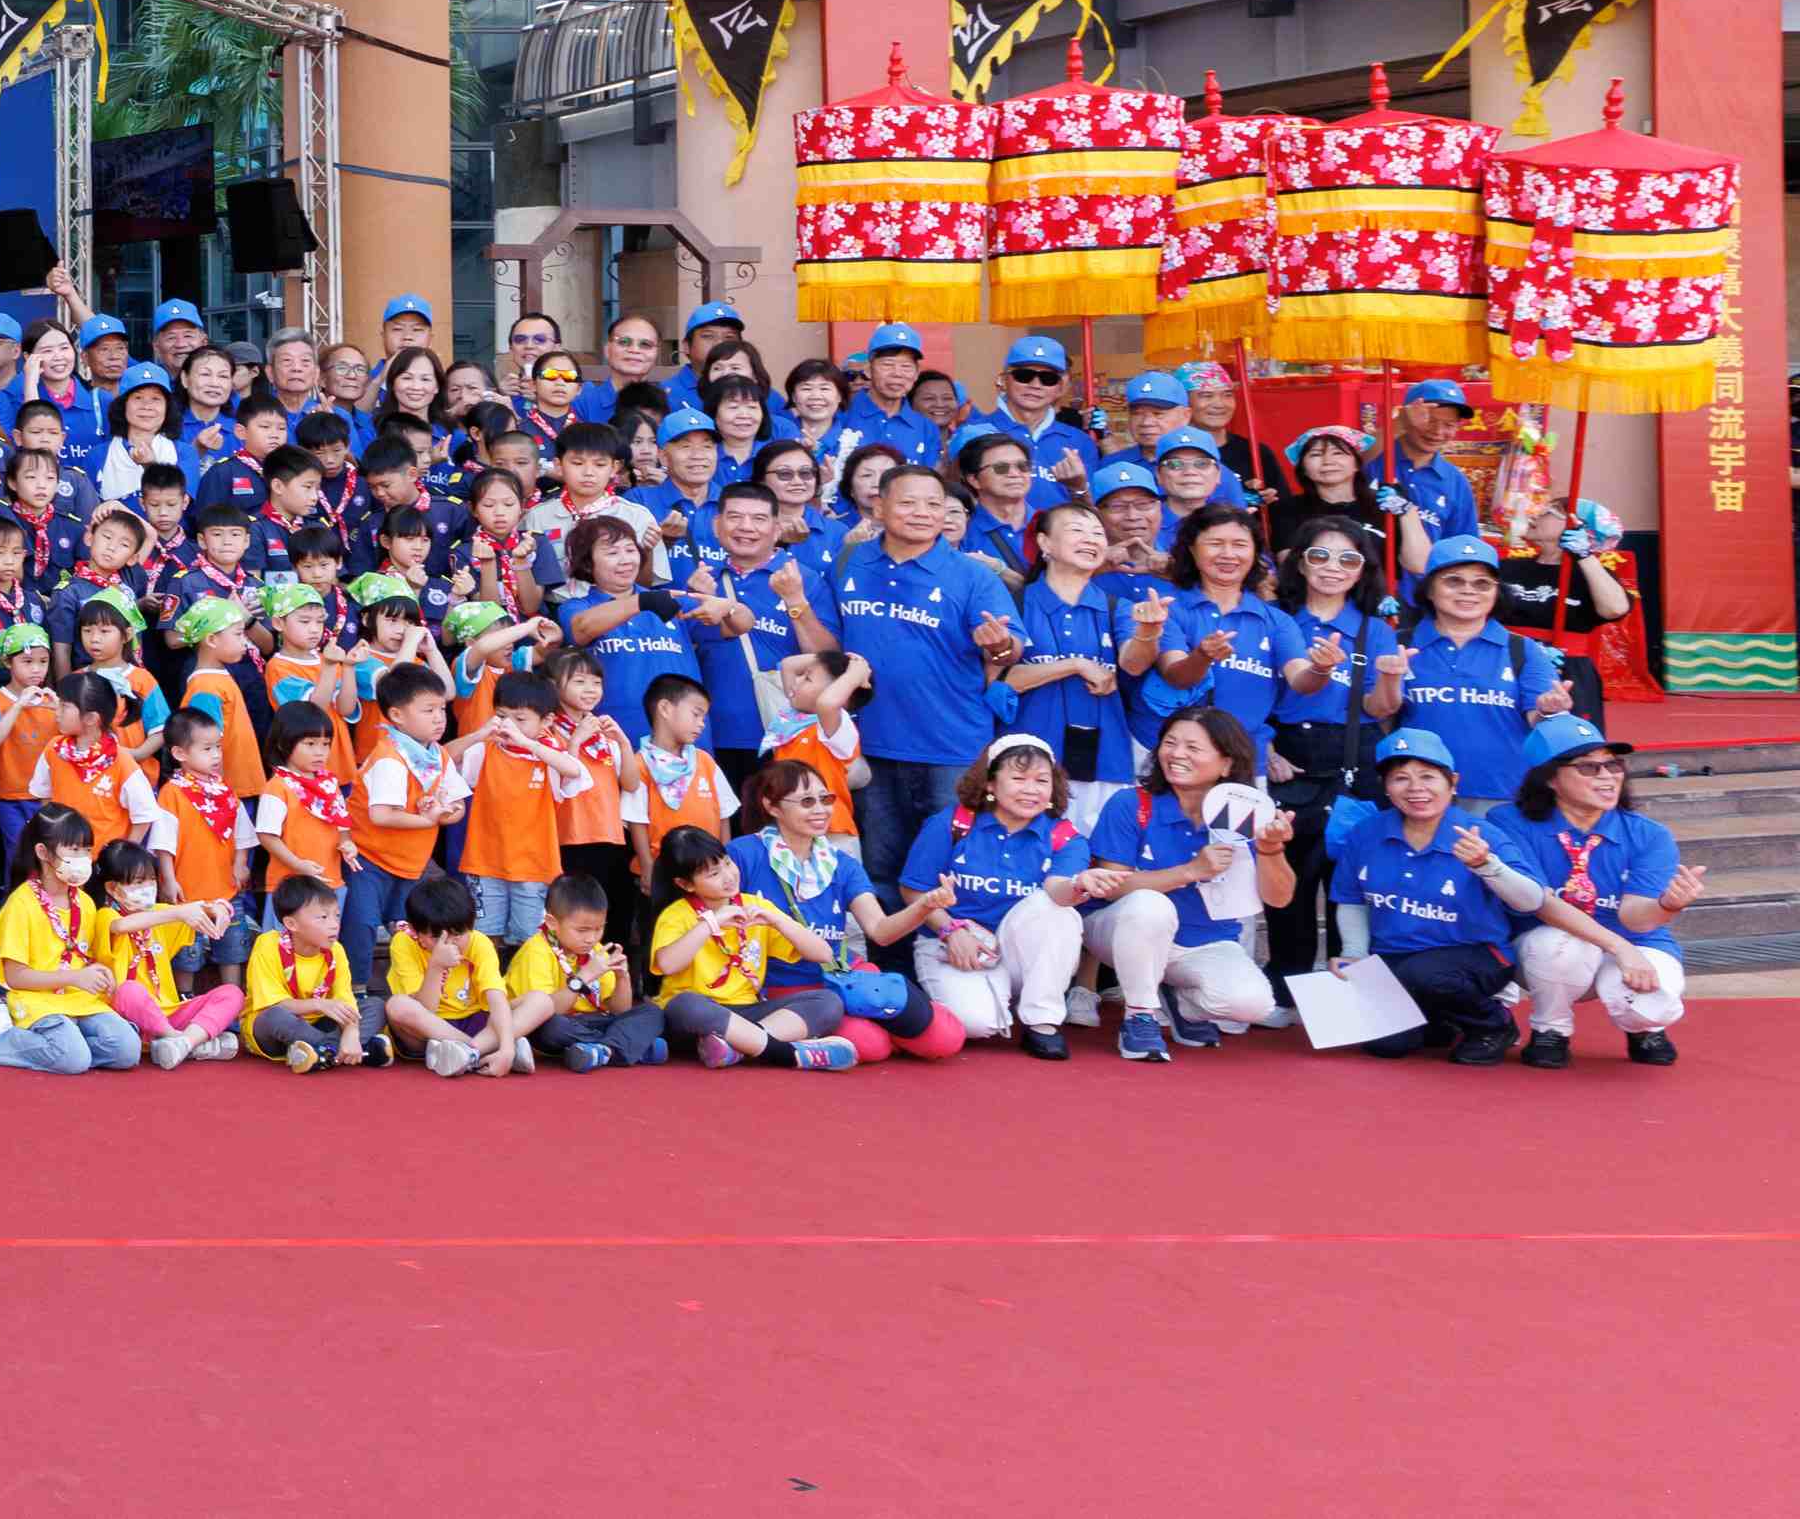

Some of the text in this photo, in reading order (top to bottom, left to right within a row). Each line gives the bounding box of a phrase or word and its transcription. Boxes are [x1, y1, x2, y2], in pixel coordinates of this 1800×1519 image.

[753, 617, 787, 636] akka
[841, 601, 940, 629] NTPC Hakka
[1220, 655, 1272, 678] Hakka
[952, 873, 1000, 894] NTPC
[1401, 899, 1457, 922] Hakka
